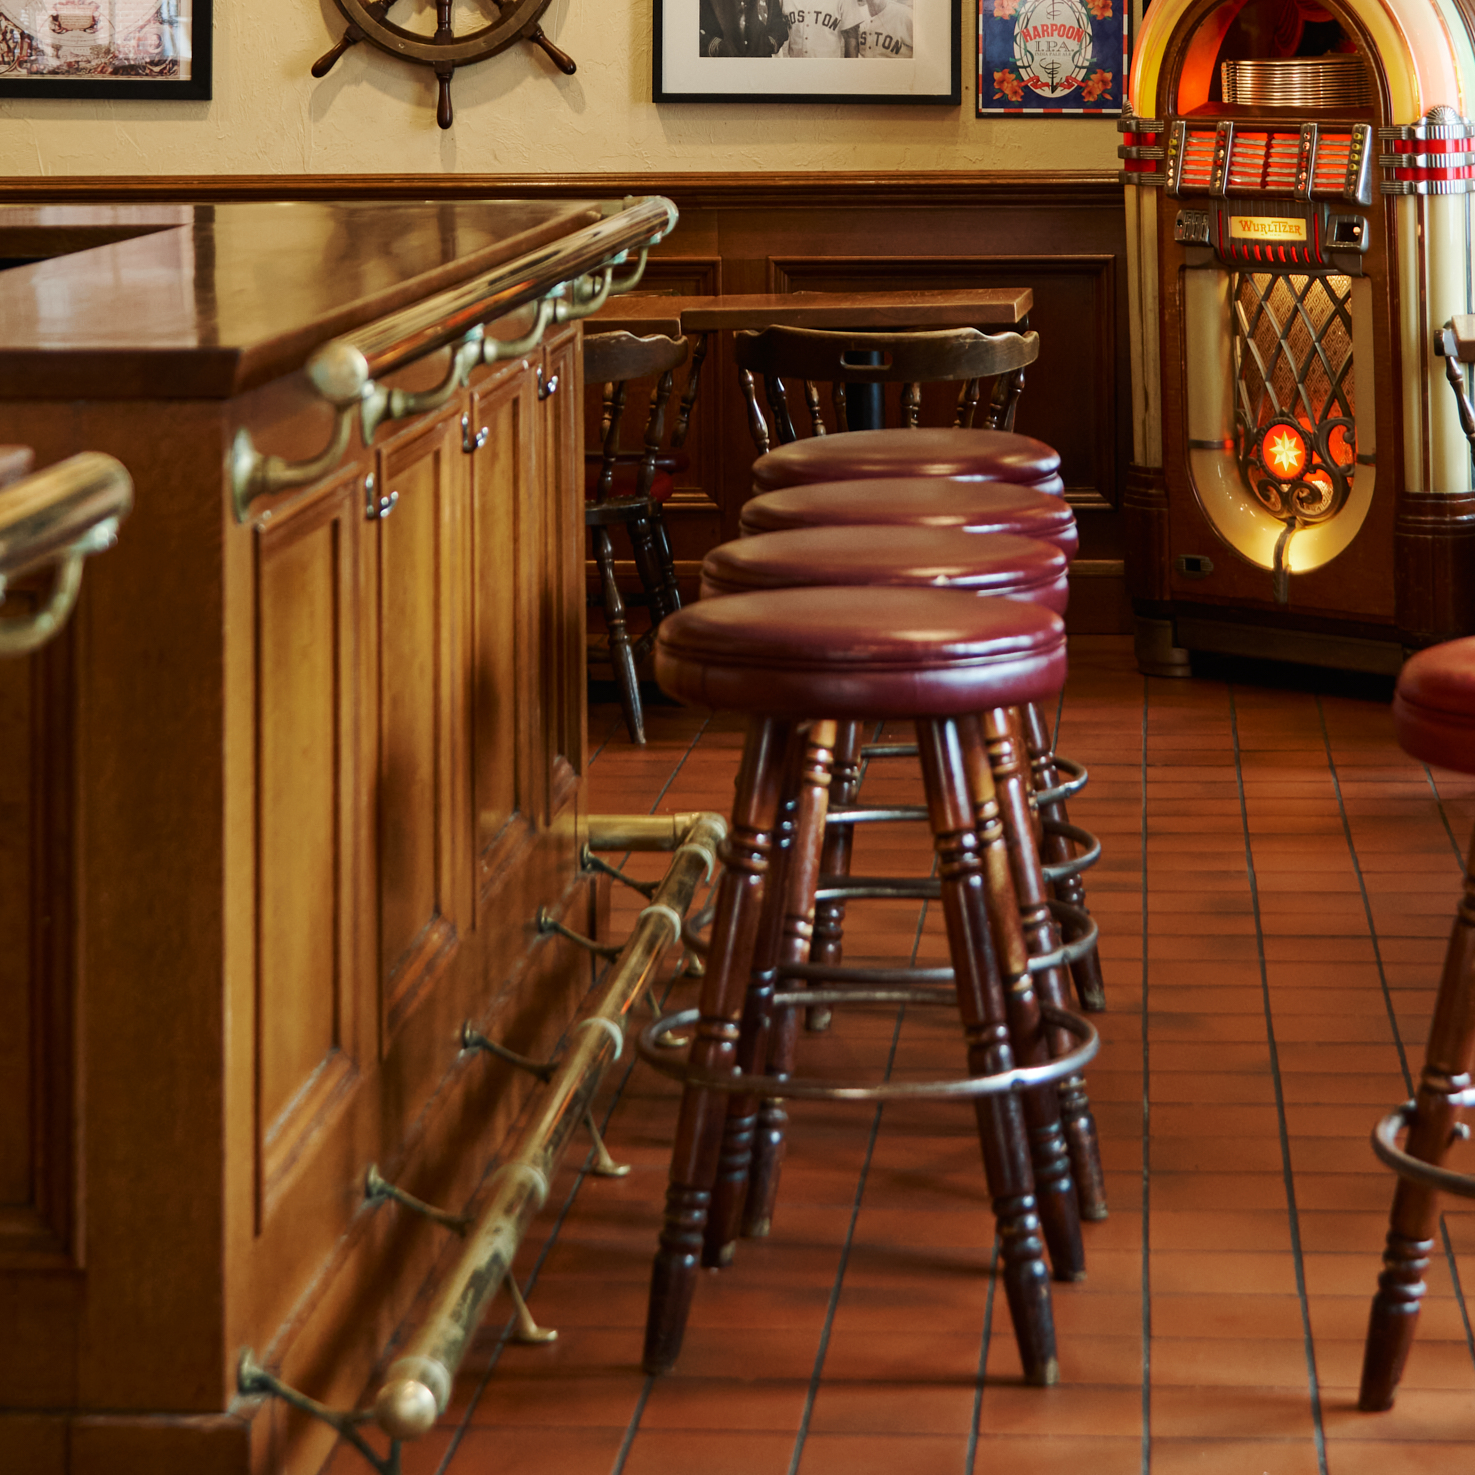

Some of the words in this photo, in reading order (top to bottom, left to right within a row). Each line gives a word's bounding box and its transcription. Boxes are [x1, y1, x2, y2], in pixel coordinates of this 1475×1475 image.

[859, 30, 903, 55] STON
[1020, 23, 1085, 43] HARPOON
[1238, 219, 1303, 236] WURLITZER
